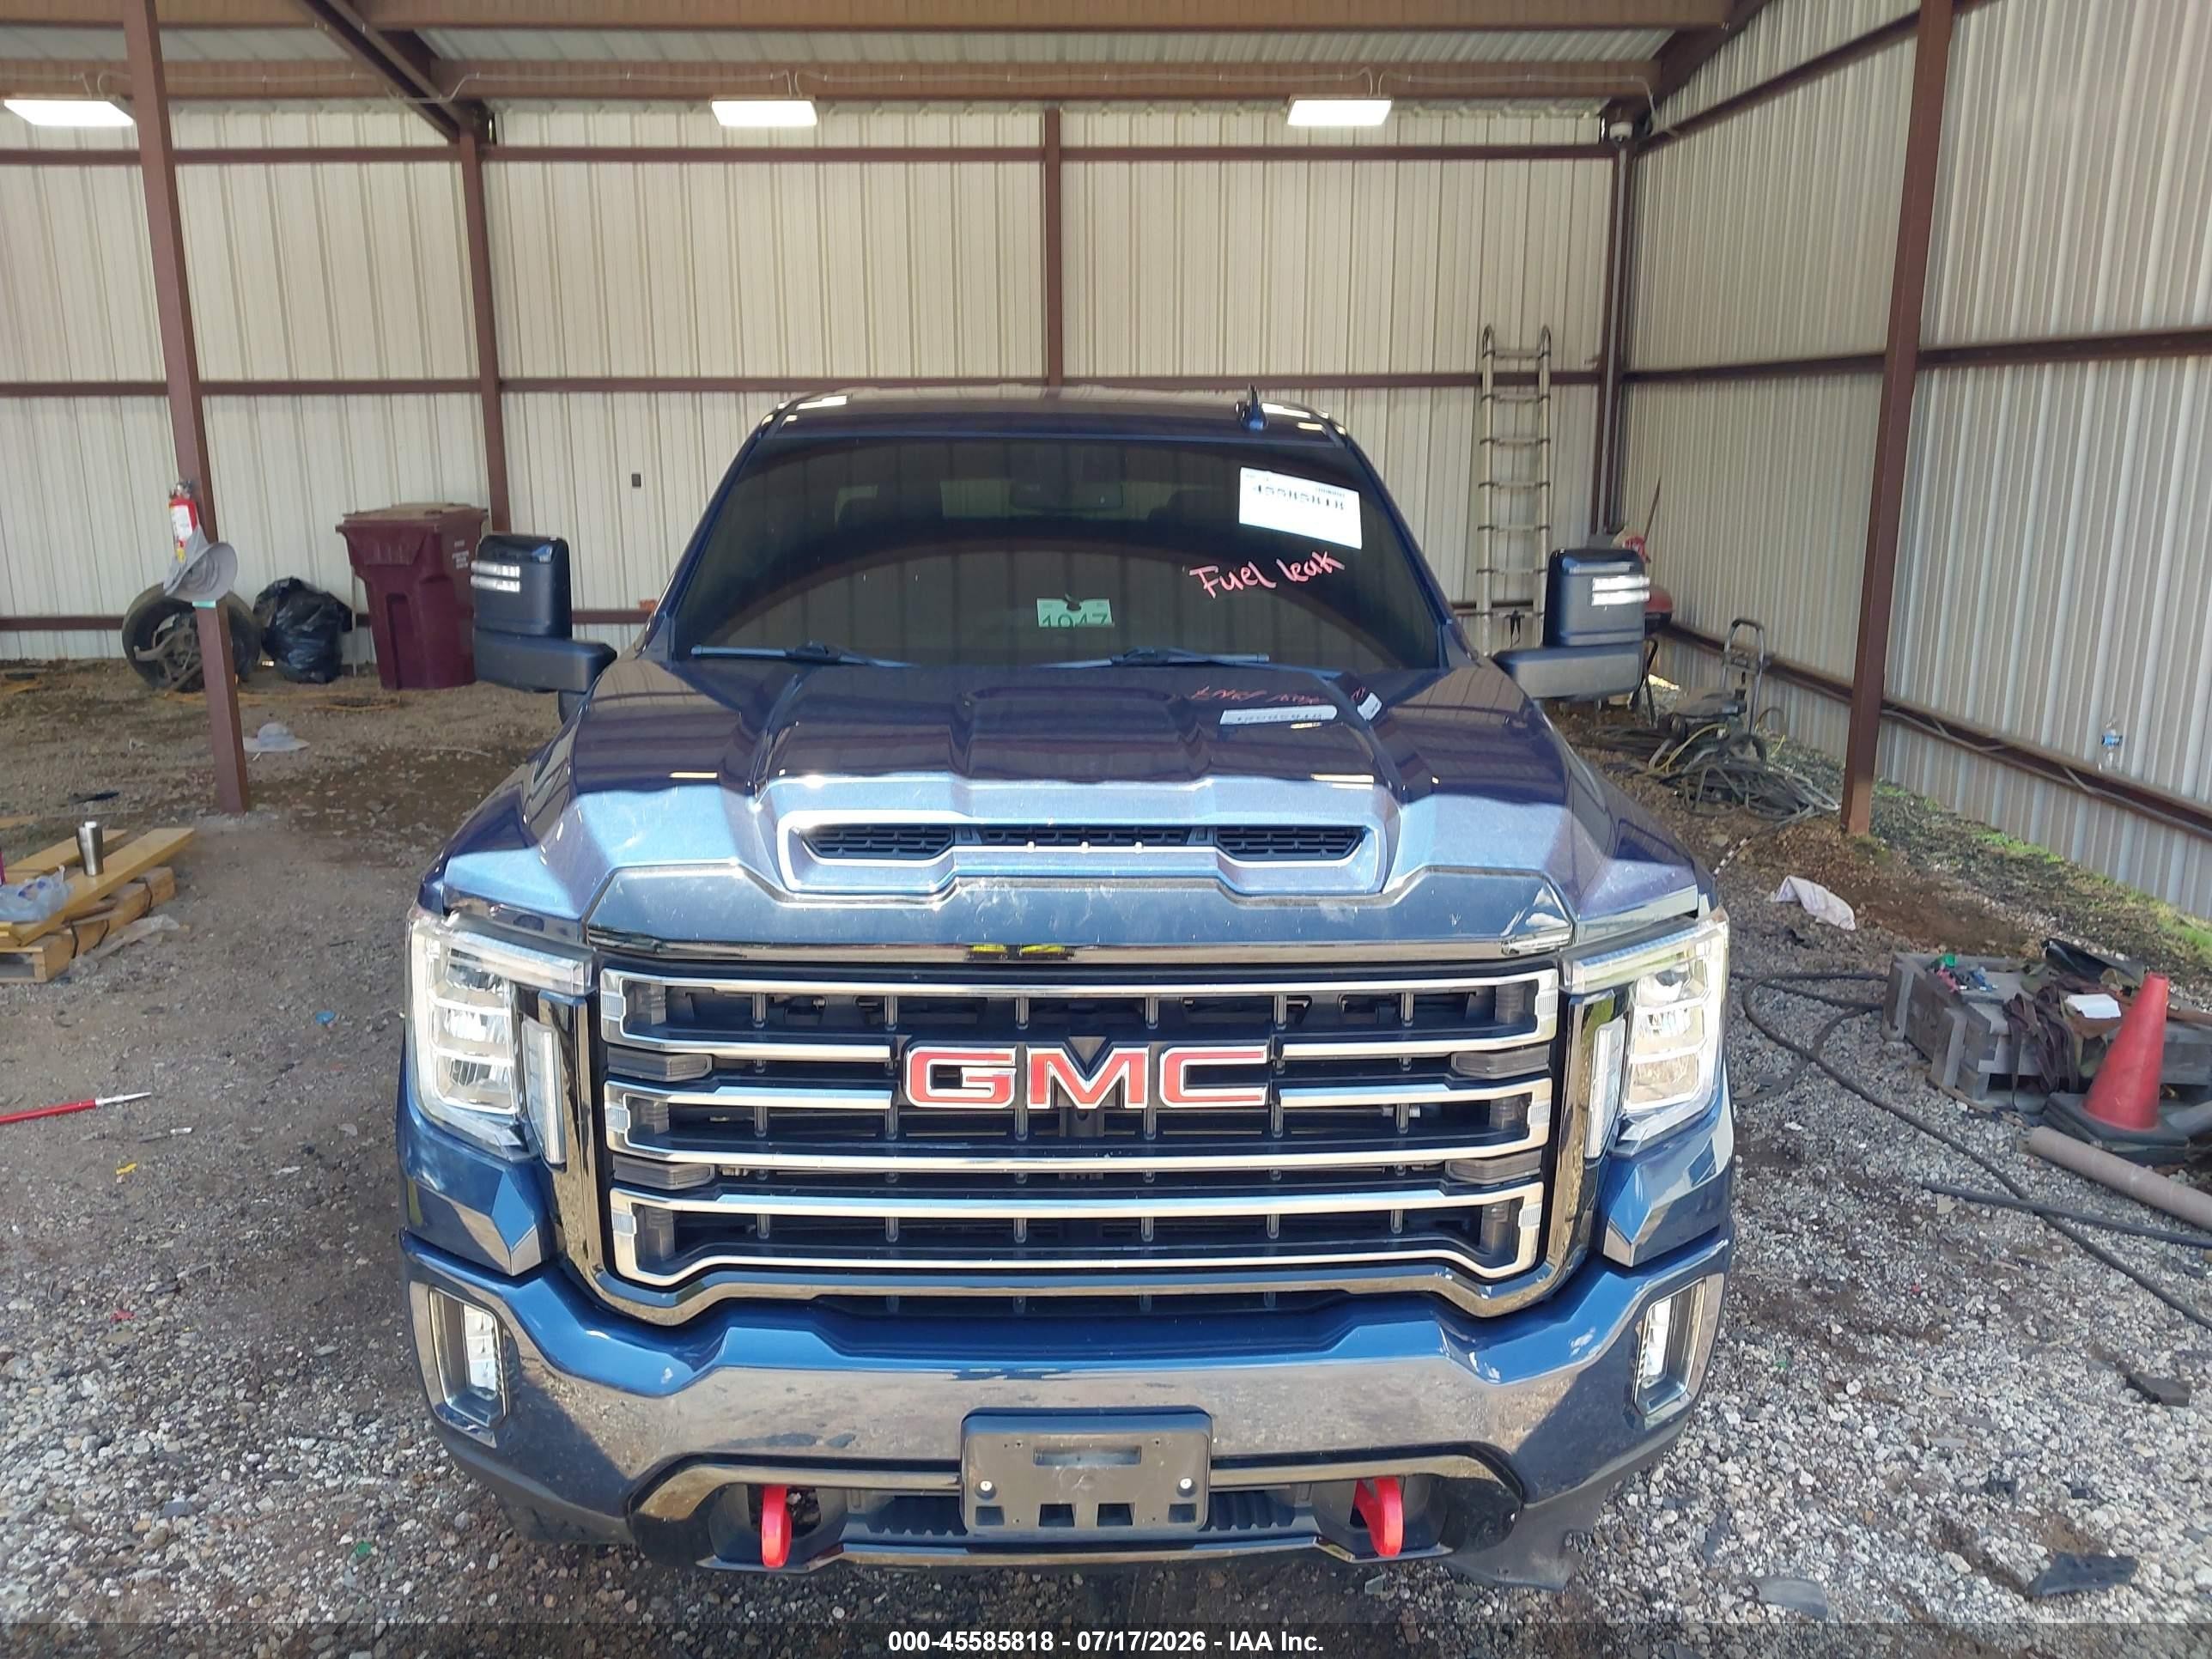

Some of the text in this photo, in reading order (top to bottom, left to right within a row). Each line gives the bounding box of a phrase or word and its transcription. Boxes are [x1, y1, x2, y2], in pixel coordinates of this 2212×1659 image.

[1188, 550, 1346, 599] Fuel leak
[905, 1044, 1268, 1109] GMC
